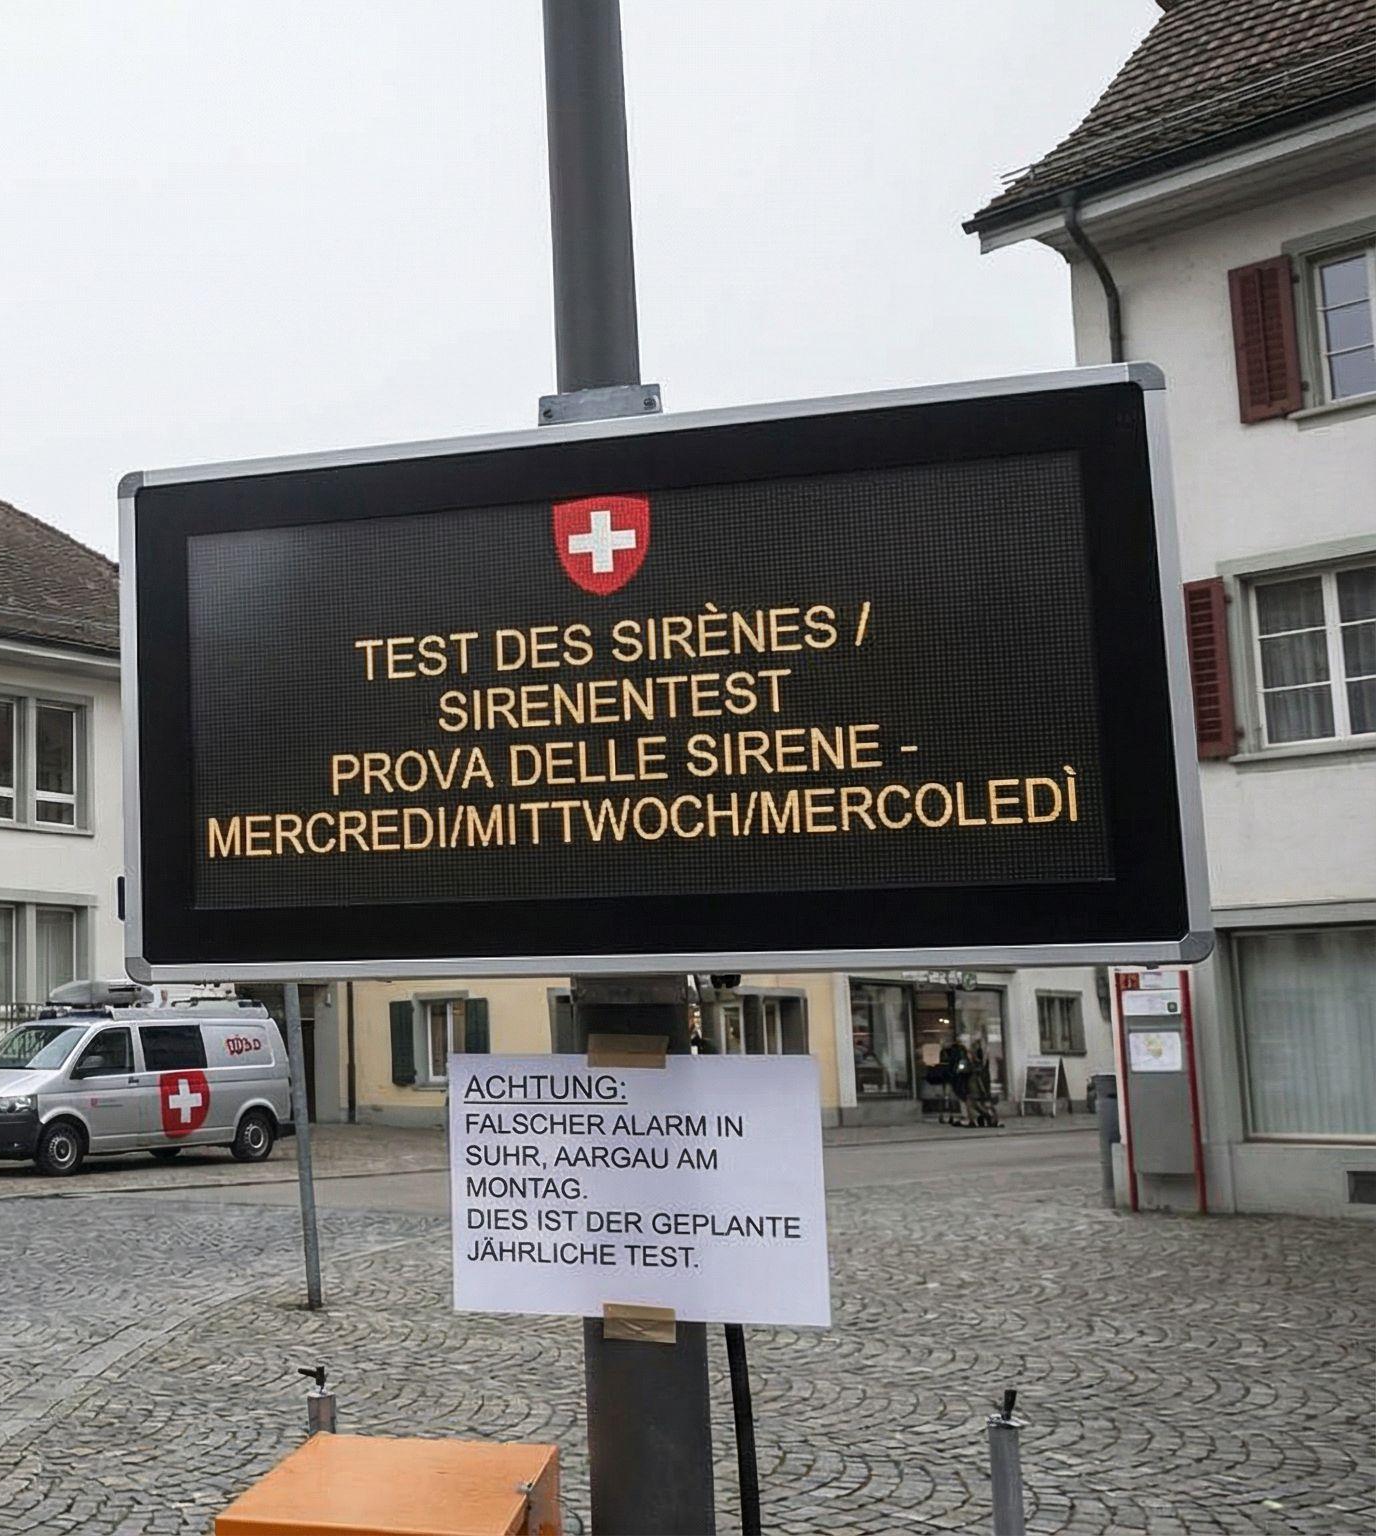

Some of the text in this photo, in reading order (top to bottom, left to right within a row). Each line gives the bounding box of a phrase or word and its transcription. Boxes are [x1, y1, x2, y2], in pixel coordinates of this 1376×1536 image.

[355, 600, 872, 680] TEST DES SIRÈNES /
[437, 668, 792, 733] SIRENENTEST
[330, 747, 493, 796] PROVA
[508, 734, 666, 786] DELLE
[686, 723, 881, 777] SIRENE
[207, 764, 1079, 859] MERCREDI/MITTWOCH/MERCOLEDÌ
[464, 1073, 627, 1101] ACHTUNG:
[465, 1112, 743, 1138] FALSCHER ALARM IN
[465, 1143, 718, 1170] SUHR, AARGAU AM
[466, 1176, 588, 1200] MONTAG.
[467, 1207, 801, 1239] DIES IST DER GEPLANTE
[466, 1235, 700, 1269] JÄHRLICHE TEST.
